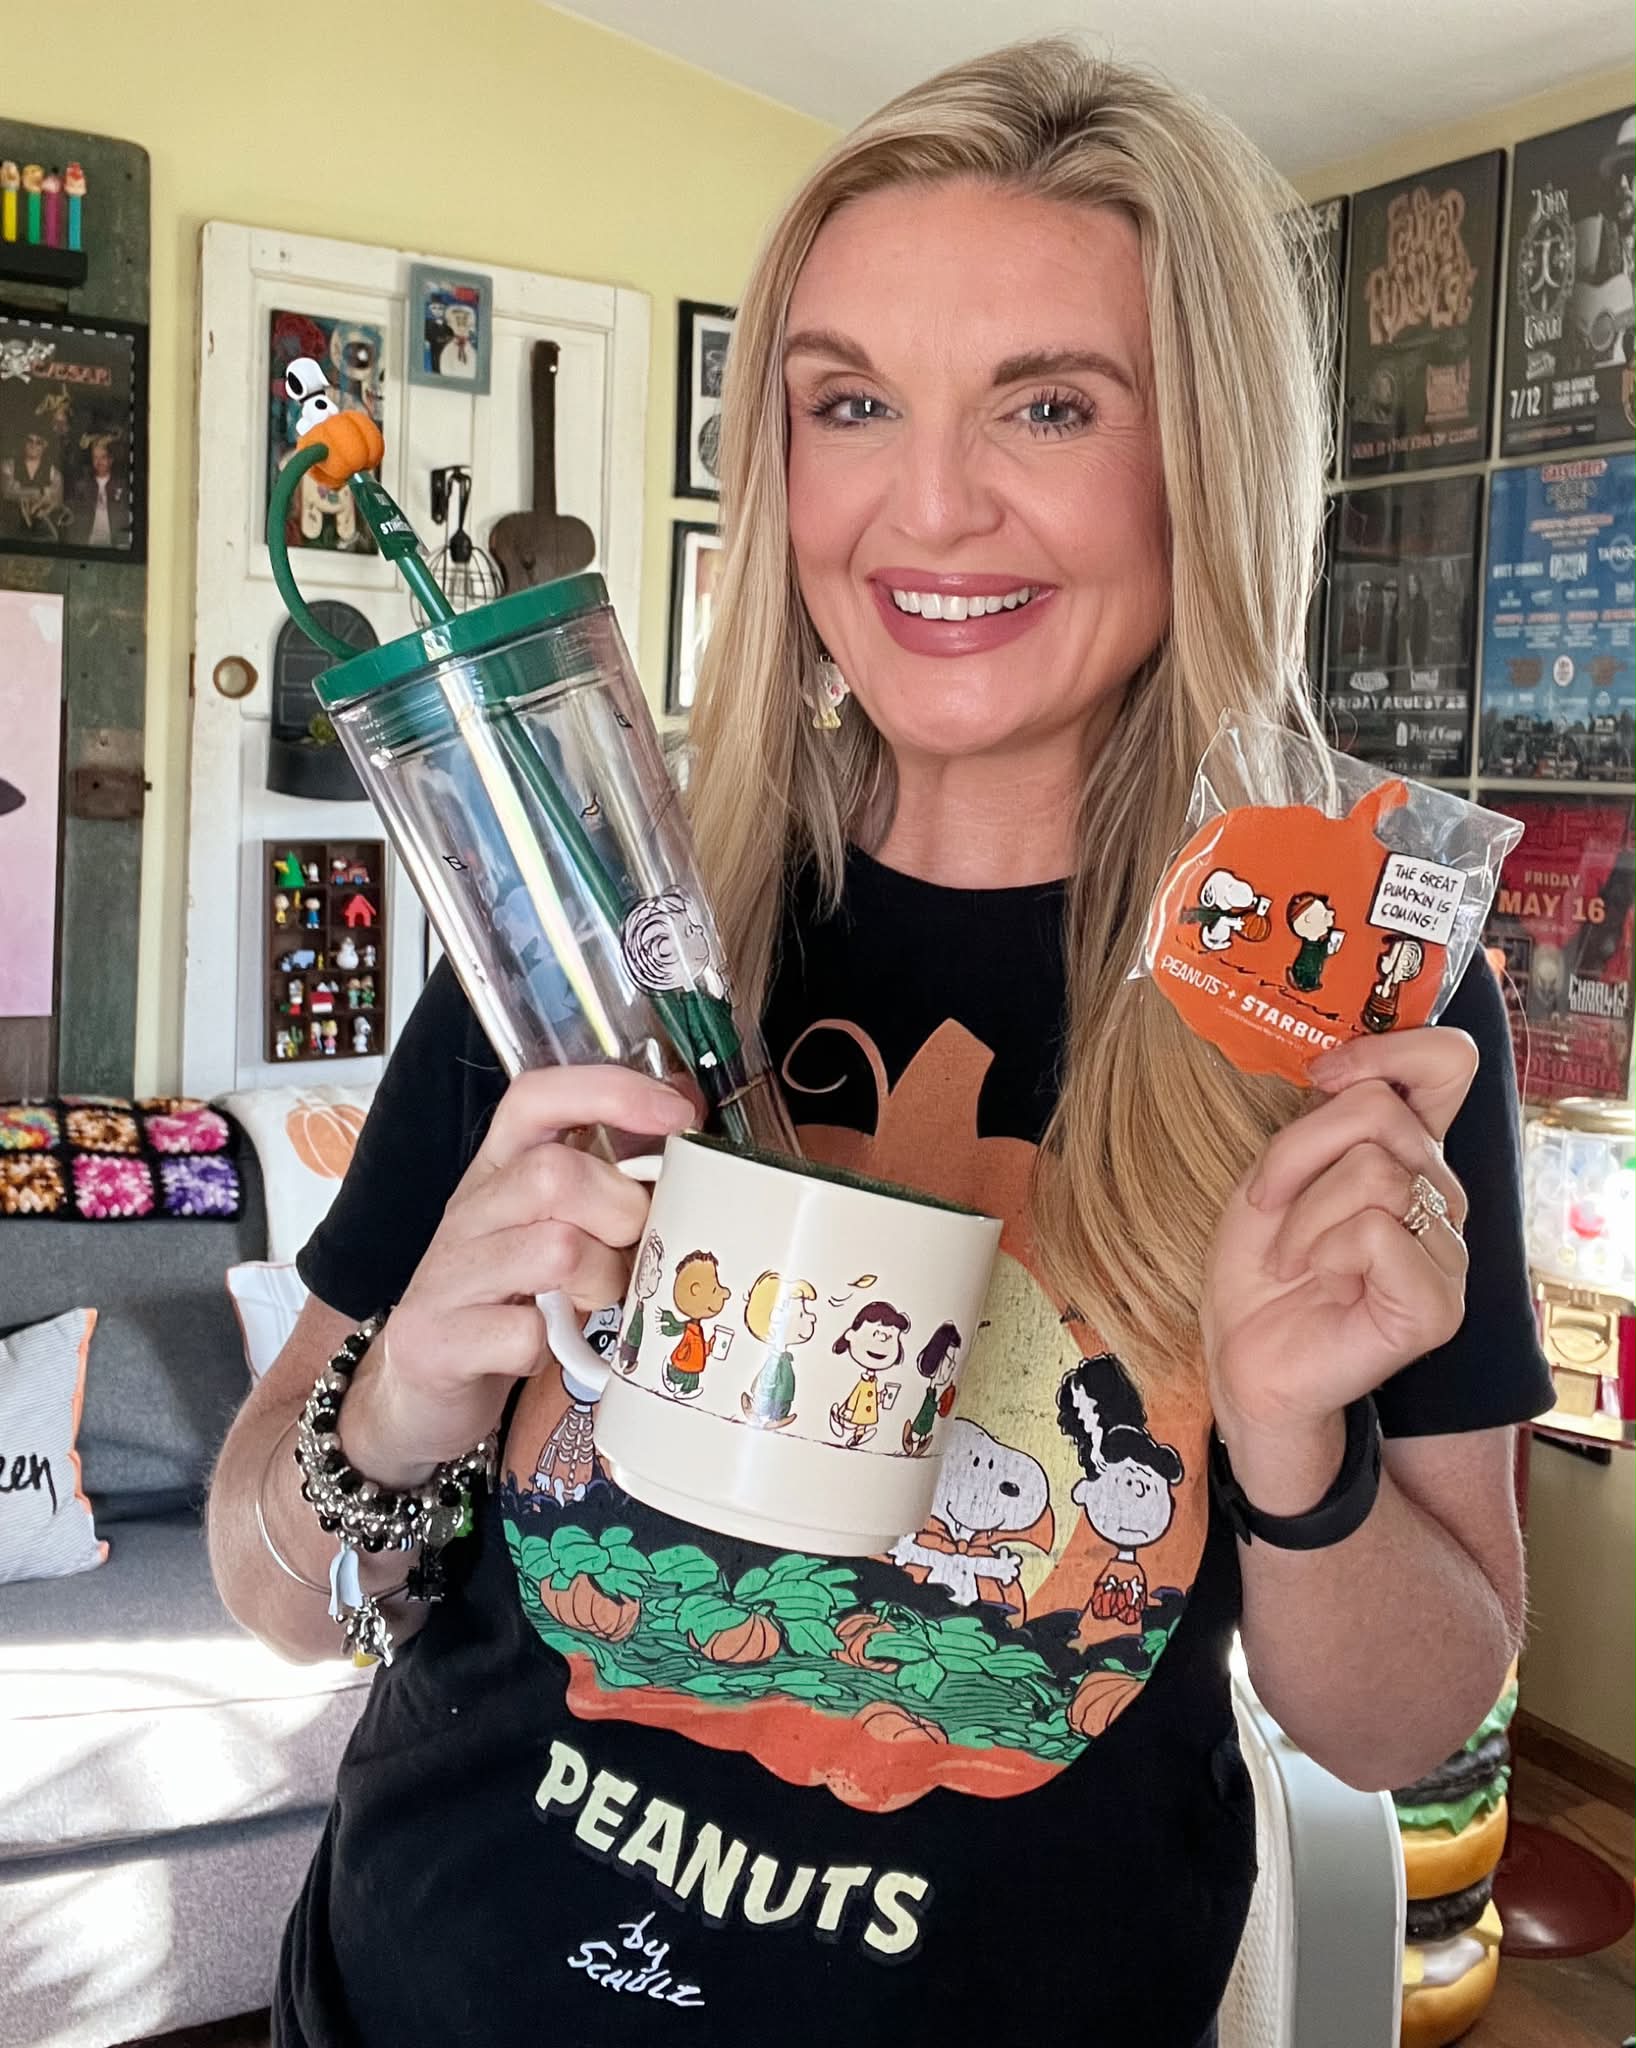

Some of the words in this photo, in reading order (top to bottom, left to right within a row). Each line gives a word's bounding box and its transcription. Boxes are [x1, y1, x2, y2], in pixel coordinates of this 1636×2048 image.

[1510, 385, 1541, 420] 7/12
[1395, 863, 1417, 881] THE
[1420, 871, 1458, 893] GREAT
[1524, 870, 1581, 888] FRIDAY
[1383, 882, 1434, 908] PUMPKIN
[1436, 900, 1452, 913] IS
[1497, 889, 1561, 918] MAY
[1571, 896, 1606, 924] 16
[1381, 902, 1439, 931] COMING!
[1240, 995, 1343, 1051] STARBUC
[534, 1740, 930, 1956] PEANUTS
